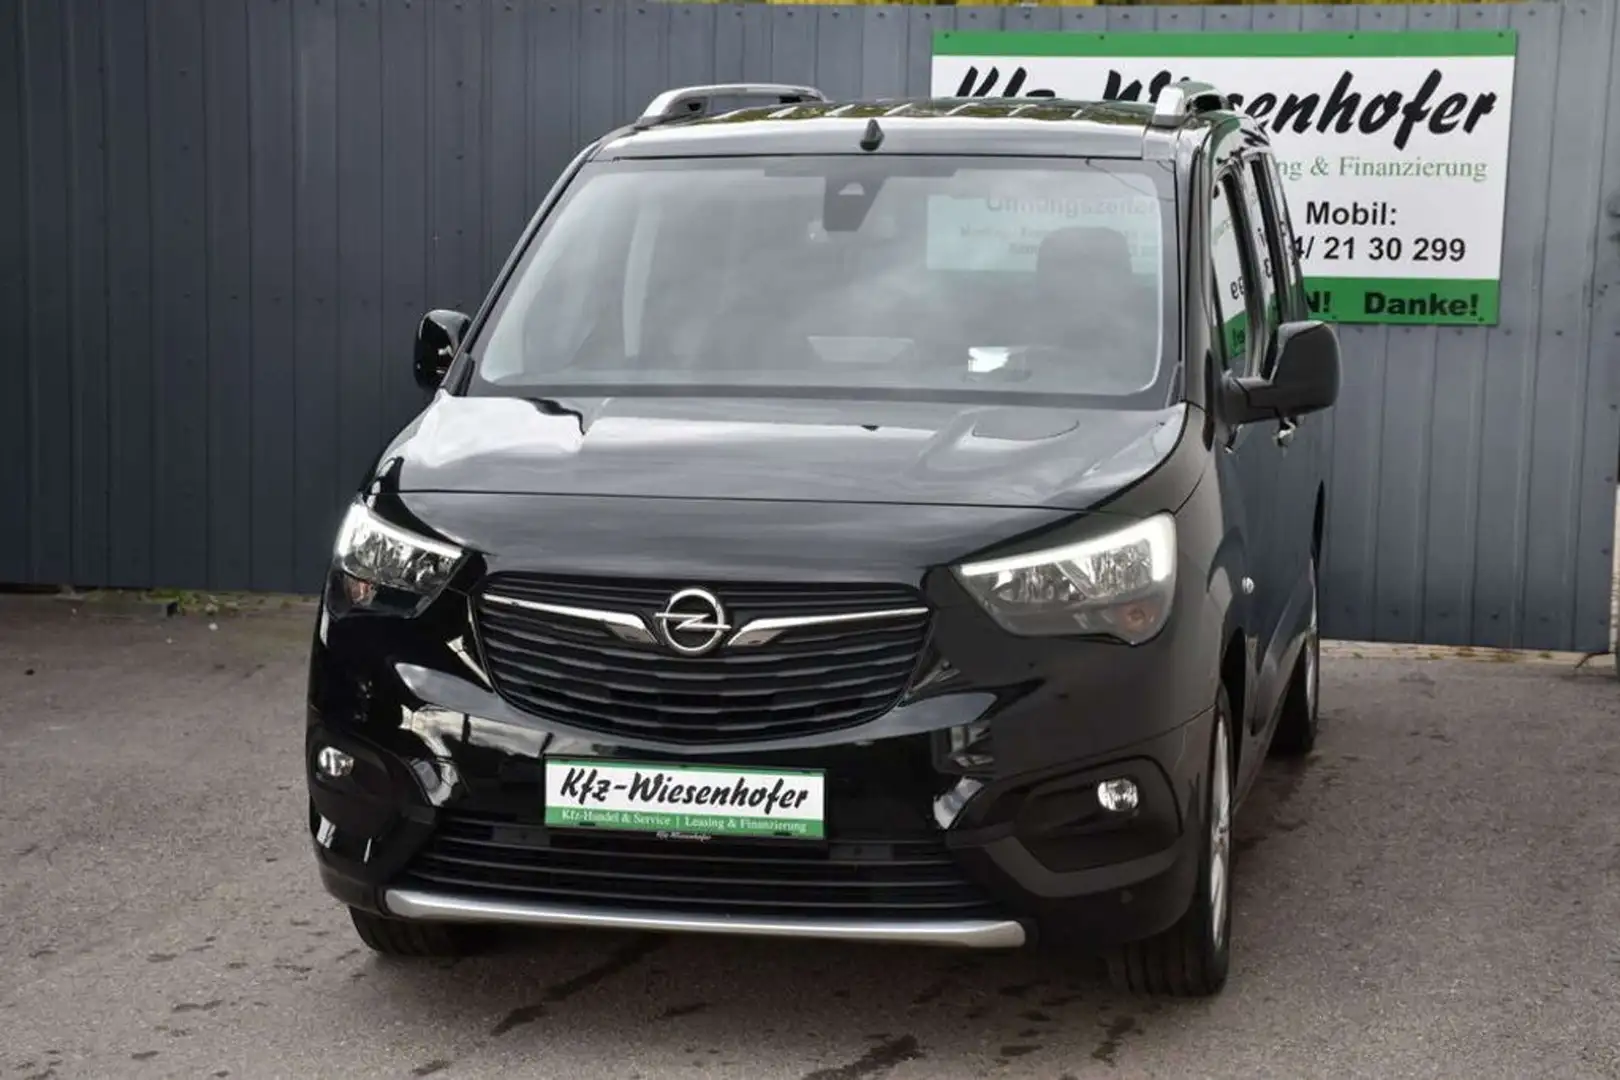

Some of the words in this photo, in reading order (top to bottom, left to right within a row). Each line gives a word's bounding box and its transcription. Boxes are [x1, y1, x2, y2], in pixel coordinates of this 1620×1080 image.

[1310, 157, 1330, 176] &
[1339, 156, 1487, 182] Finanzierung
[1306, 201, 1398, 225] Mobil:
[1324, 236, 1355, 260] 21
[1369, 238, 1402, 261] 30
[1413, 238, 1466, 262] 299
[1364, 291, 1479, 316] Danke!
[560, 767, 808, 814] Kfz-Wiesenhofer
[634, 814, 671, 826] Service
[685, 816, 725, 831] Leasing
[740, 819, 807, 834] Finanzierung
